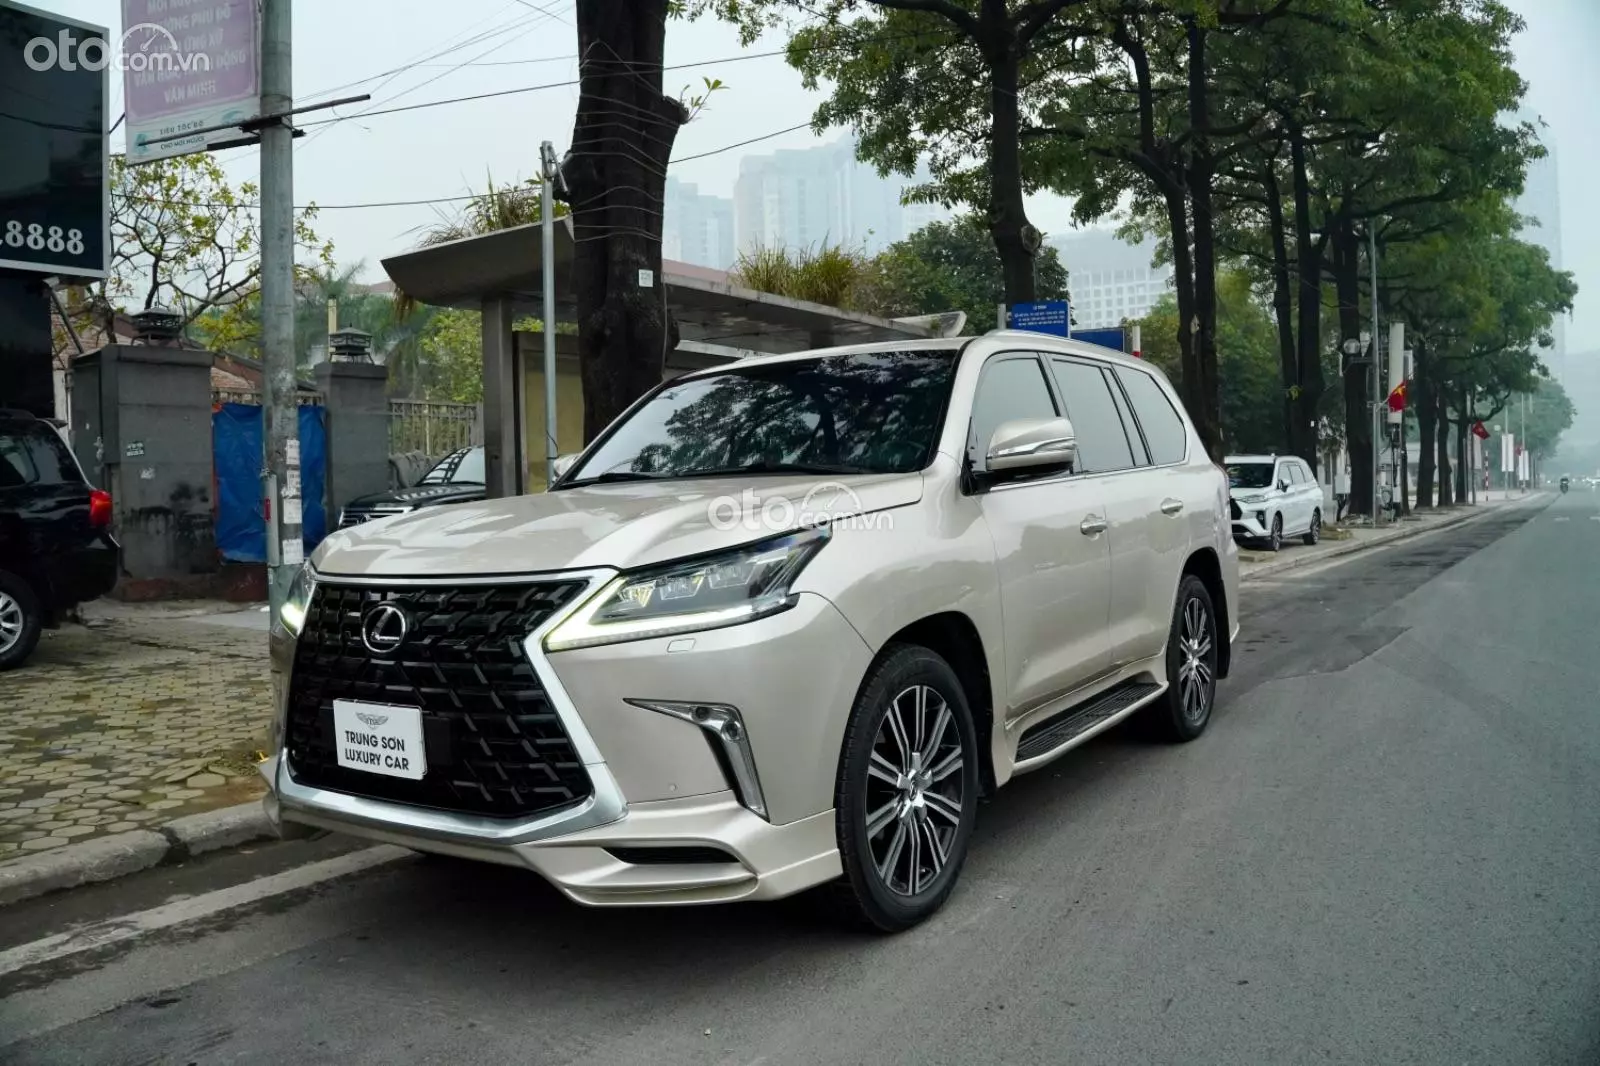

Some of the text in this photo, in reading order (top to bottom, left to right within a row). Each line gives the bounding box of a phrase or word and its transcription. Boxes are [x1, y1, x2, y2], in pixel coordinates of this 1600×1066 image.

[345, 730, 379, 748] TRUNG
[345, 748, 409, 771] LUXURY CAR
